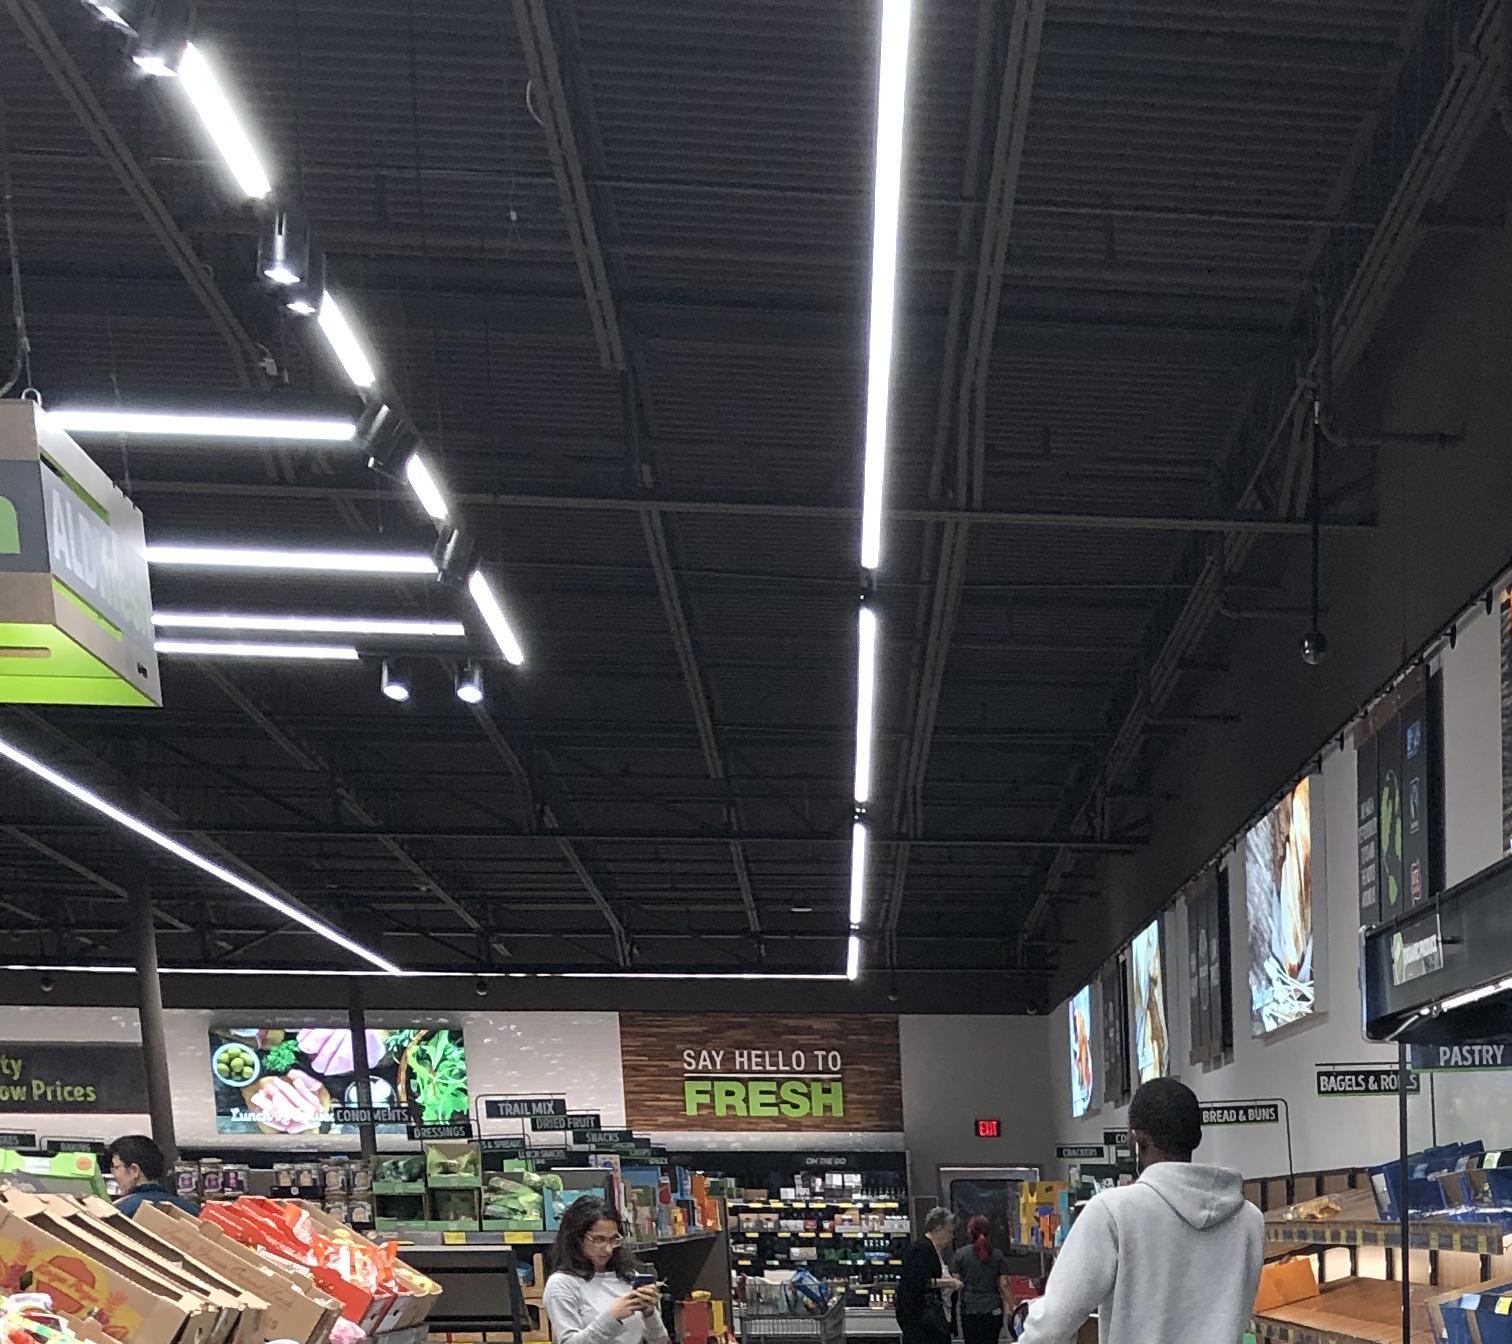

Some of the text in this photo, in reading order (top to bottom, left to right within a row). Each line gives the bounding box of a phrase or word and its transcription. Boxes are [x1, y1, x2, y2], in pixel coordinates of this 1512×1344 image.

[683, 1050, 842, 1071] SAY HELLO TO
[1440, 1045, 1504, 1066] PASTRY
[32, 1079, 97, 1102] Prices
[1320, 1073, 1418, 1092] BAGELS & ROS
[684, 1080, 844, 1118] FRESH
[337, 1109, 409, 1123] CONDIMENTS
[498, 1100, 555, 1116] TRAIL MIX
[1202, 1107, 1276, 1123] BREAD & BUNS
[535, 1116, 596, 1129] DRIED FRUIT
[978, 1121, 998, 1137] EXIT
[414, 1124, 466, 1139] DRESSINGS
[585, 1131, 620, 1142] SNACKS
[1063, 1148, 1098, 1158] CRACKERS
